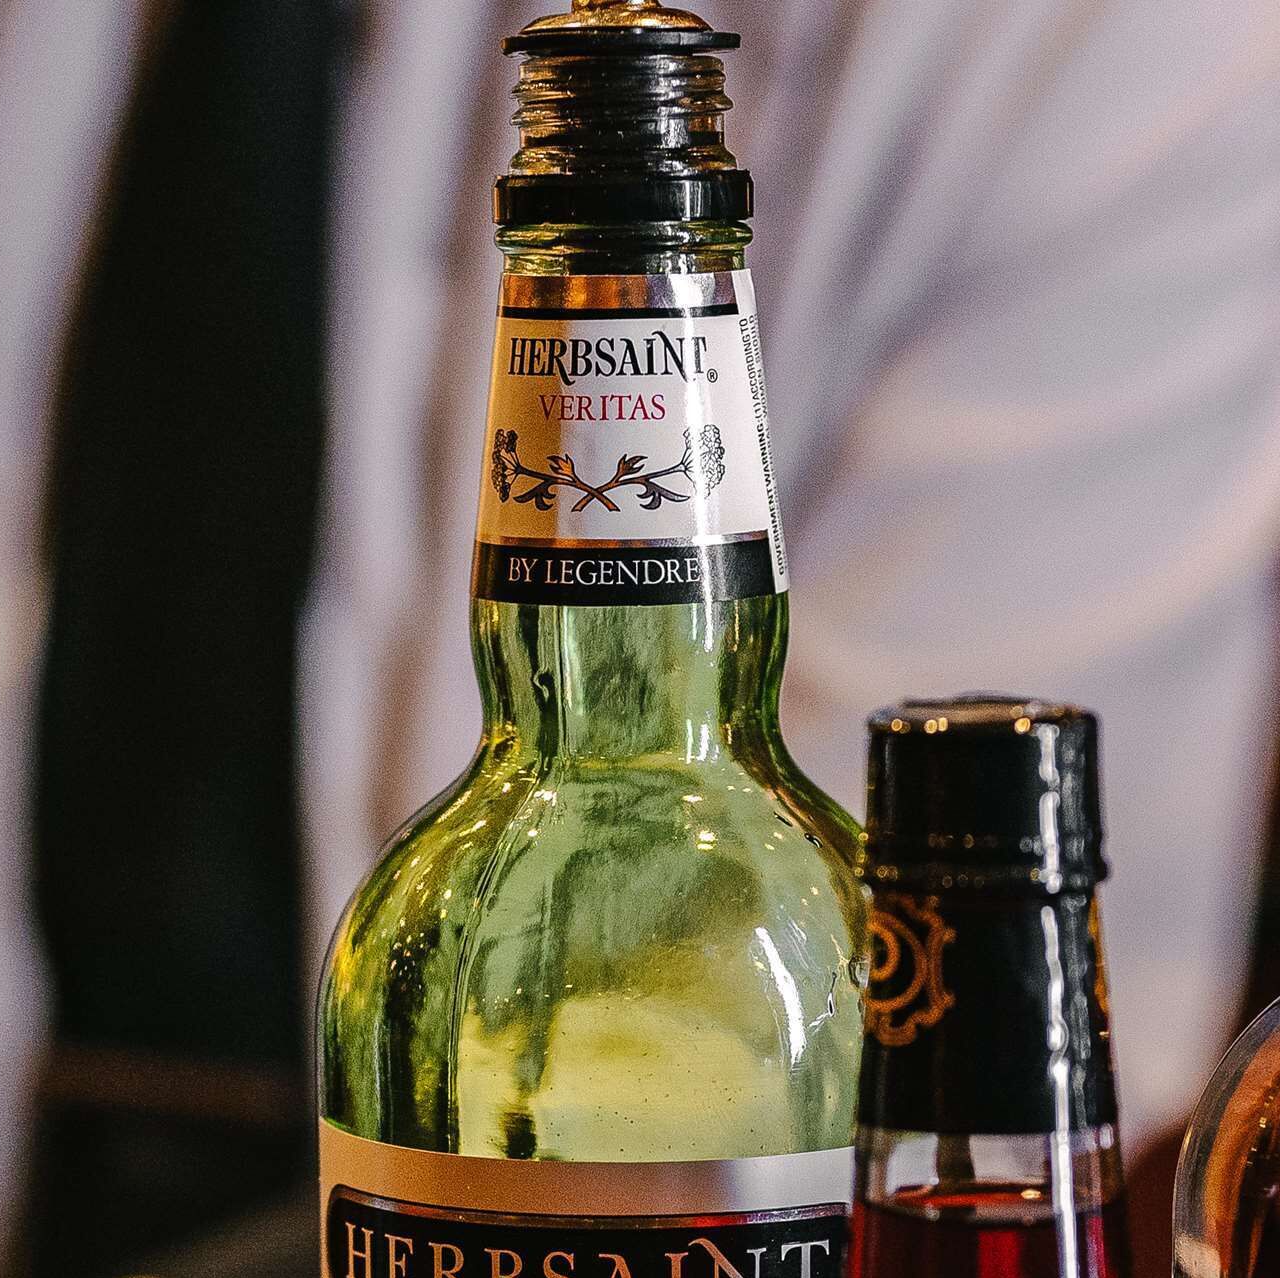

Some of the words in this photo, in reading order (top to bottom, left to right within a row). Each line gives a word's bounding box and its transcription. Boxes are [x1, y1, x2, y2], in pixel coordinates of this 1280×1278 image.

[739, 318, 749, 335] TO
[507, 330, 707, 386] HERBSAINT
[742, 335, 760, 400] ACCORDING
[539, 393, 667, 422] VERITAS
[766, 487, 784, 576] GOVERNMENT
[508, 557, 538, 583] BY
[546, 557, 703, 586] LEGENDRE
